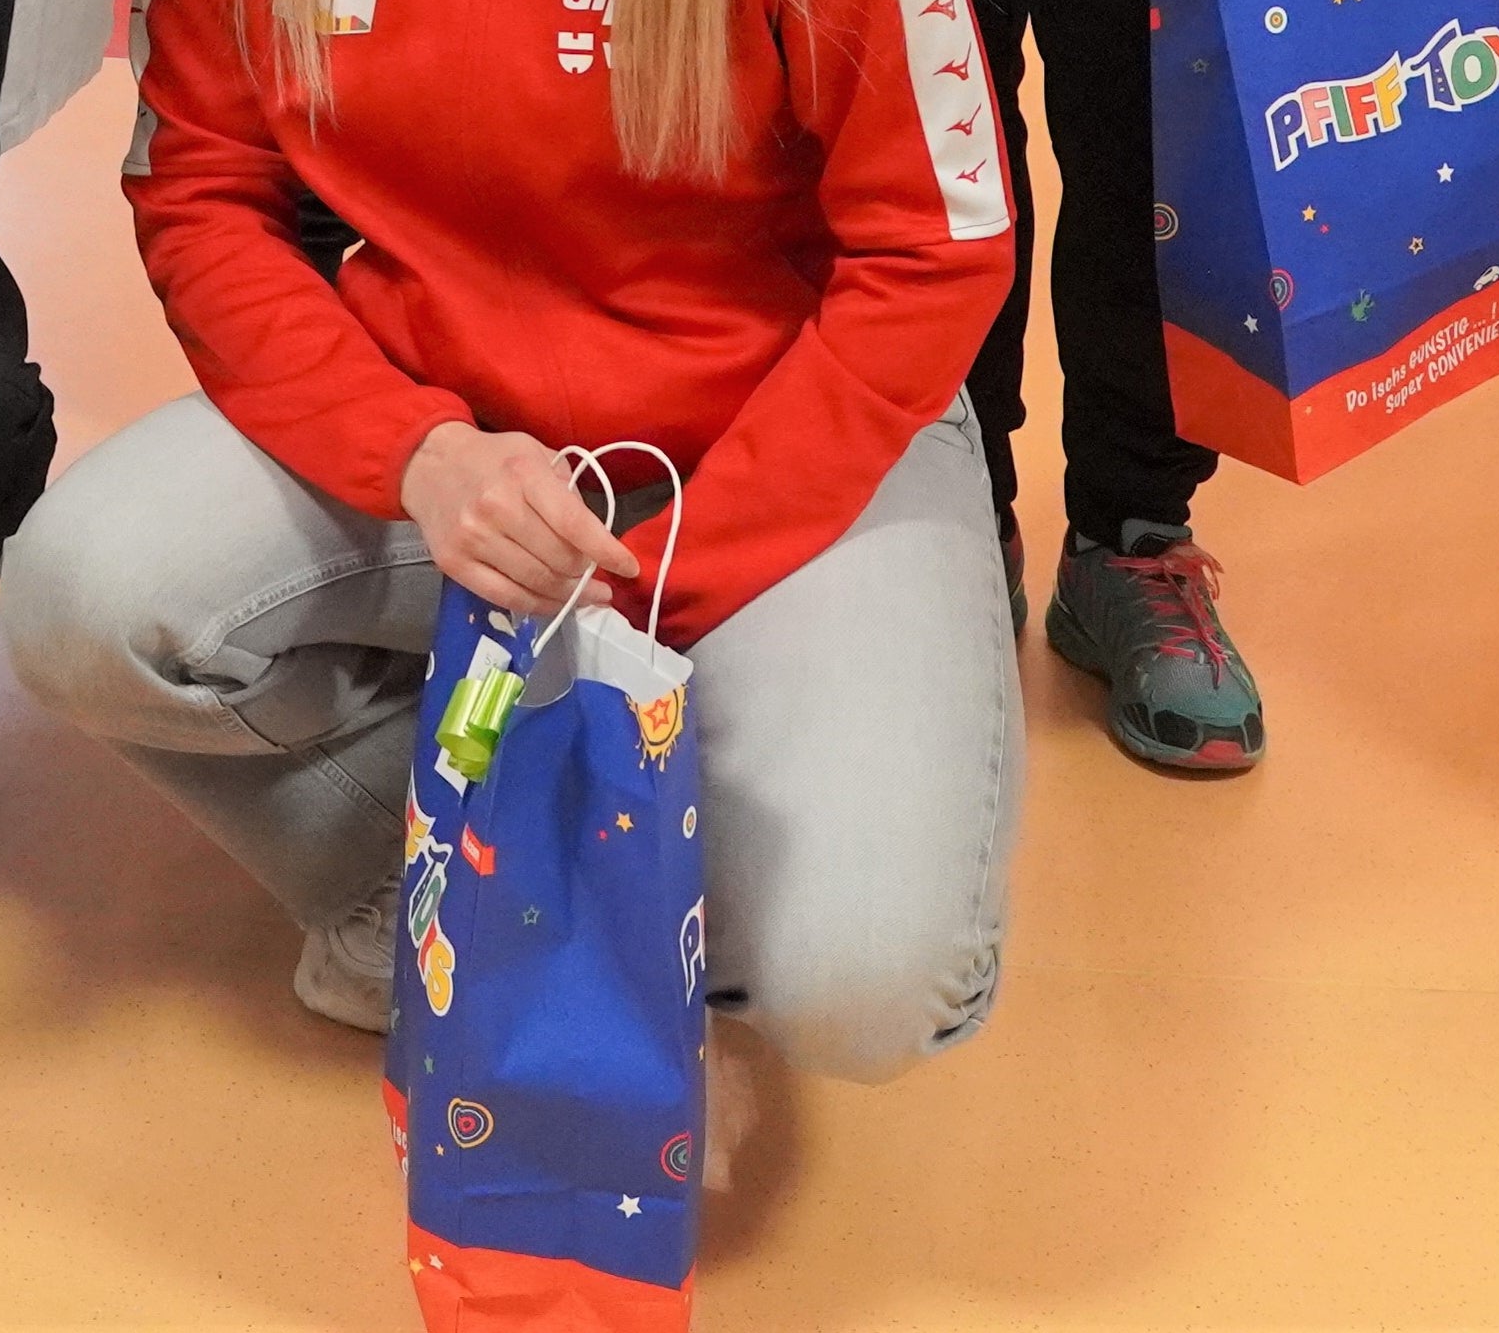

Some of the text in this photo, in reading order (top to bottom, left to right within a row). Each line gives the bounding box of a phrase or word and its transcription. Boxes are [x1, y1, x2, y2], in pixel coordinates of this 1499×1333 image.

[1267, 54, 1406, 168] PFIFF
[1345, 389, 1368, 413] Do
[1371, 363, 1407, 402] ischs
[1385, 372, 1425, 415] Super
